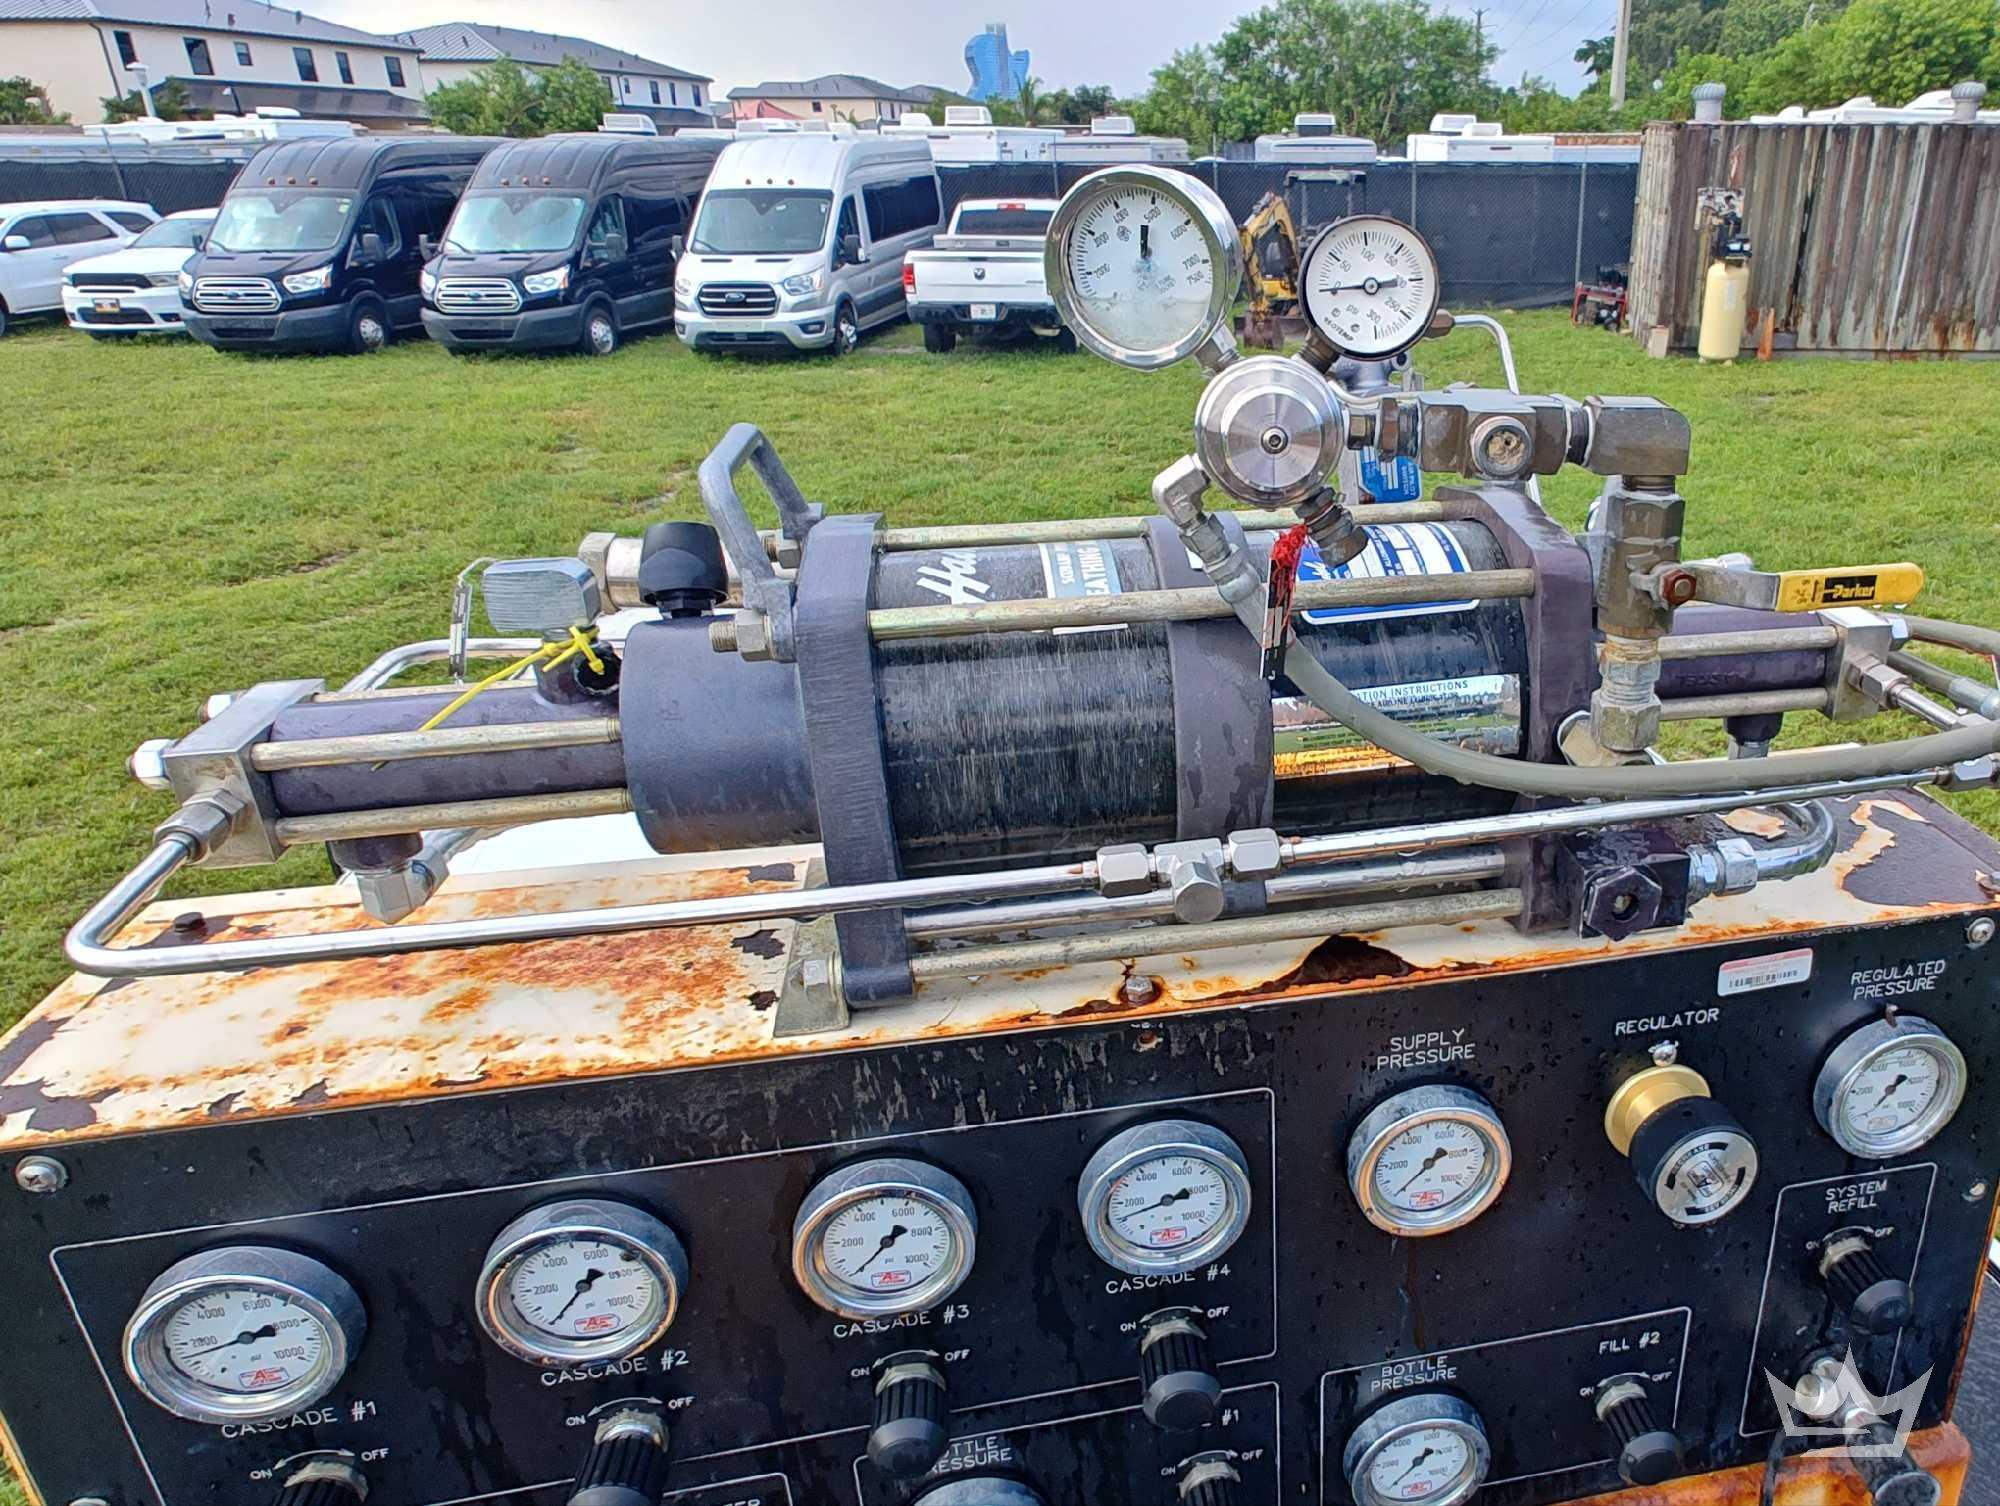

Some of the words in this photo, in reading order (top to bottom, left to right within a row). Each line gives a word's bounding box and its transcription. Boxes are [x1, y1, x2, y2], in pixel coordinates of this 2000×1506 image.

[1359, 247, 1375, 262] 100
[1384, 252, 1398, 267] 150
[1340, 260, 1352, 272] 50
[1384, 296, 1401, 312] 250
[1366, 309, 1381, 324] 300
[1832, 583, 1875, 599] Parker
[1391, 680, 1469, 698] INSTRUCTIONS
[1851, 959, 1946, 985] REGULATED
[1853, 976, 1938, 1001] PRESSURE
[1614, 1007, 1721, 1037] REGULATOR
[1390, 1028, 1465, 1051] SUPPLY
[1377, 1043, 1476, 1071] PRESSURE
[1402, 1135, 1422, 1146] 4000
[1434, 1129, 1456, 1140] 6000
[1449, 1148, 1469, 1159] 8000
[1171, 1166, 1193, 1176] 6000
[1388, 1160, 1409, 1170] 2000
[1135, 1172, 1157, 1182] 4000
[1825, 1179, 1888, 1201] SYSTEM
[1124, 1197, 1145, 1207] 2000
[1827, 1195, 1878, 1214] REFILL
[891, 1207, 915, 1217] 6000
[1182, 1211, 1205, 1221] 10000
[911, 1226, 933, 1237] 8000
[1874, 1227, 1896, 1239] OFF
[841, 1237, 864, 1248] 2000
[542, 1256, 568, 1268] 4000
[583, 1249, 609, 1260] 6000
[1105, 1270, 1196, 1295] CASCADE
[1207, 1264, 1231, 1281] #4
[533, 1283, 558, 1295] 2000
[242, 1298, 272, 1311] 6000
[606, 1294, 634, 1308] 10000
[197, 1307, 225, 1320] 4000
[833, 1310, 932, 1338] CASCADE
[943, 1304, 970, 1323] #3
[1120, 1322, 1137, 1332] ON
[1207, 1306, 1230, 1319] OFF
[272, 1317, 300, 1330] 8000
[190, 1335, 218, 1348] 2000
[1599, 1338, 1630, 1354] FILL
[1638, 1331, 1661, 1349] #2
[273, 1346, 305, 1360] 10000
[540, 1356, 648, 1387] CASCADE
[660, 1350, 689, 1371] #2
[851, 1367, 871, 1377] ON
[944, 1349, 971, 1362] OFF
[1381, 1356, 1448, 1378] BOTTLE
[1371, 1367, 1458, 1392] PRESSURE
[1579, 1386, 1595, 1397] ON
[1652, 1371, 1673, 1382] OFF
[220, 1406, 338, 1438] CASCADE
[350, 1400, 378, 1422] #1
[565, 1415, 586, 1427] ON
[668, 1396, 695, 1410] OFF
[1221, 1409, 1240, 1426] #1
[249, 1469, 273, 1480] ON
[361, 1447, 389, 1462] OFF
[1161, 1467, 1177, 1476] ON
[1241, 1449, 1264, 1461] OFF
